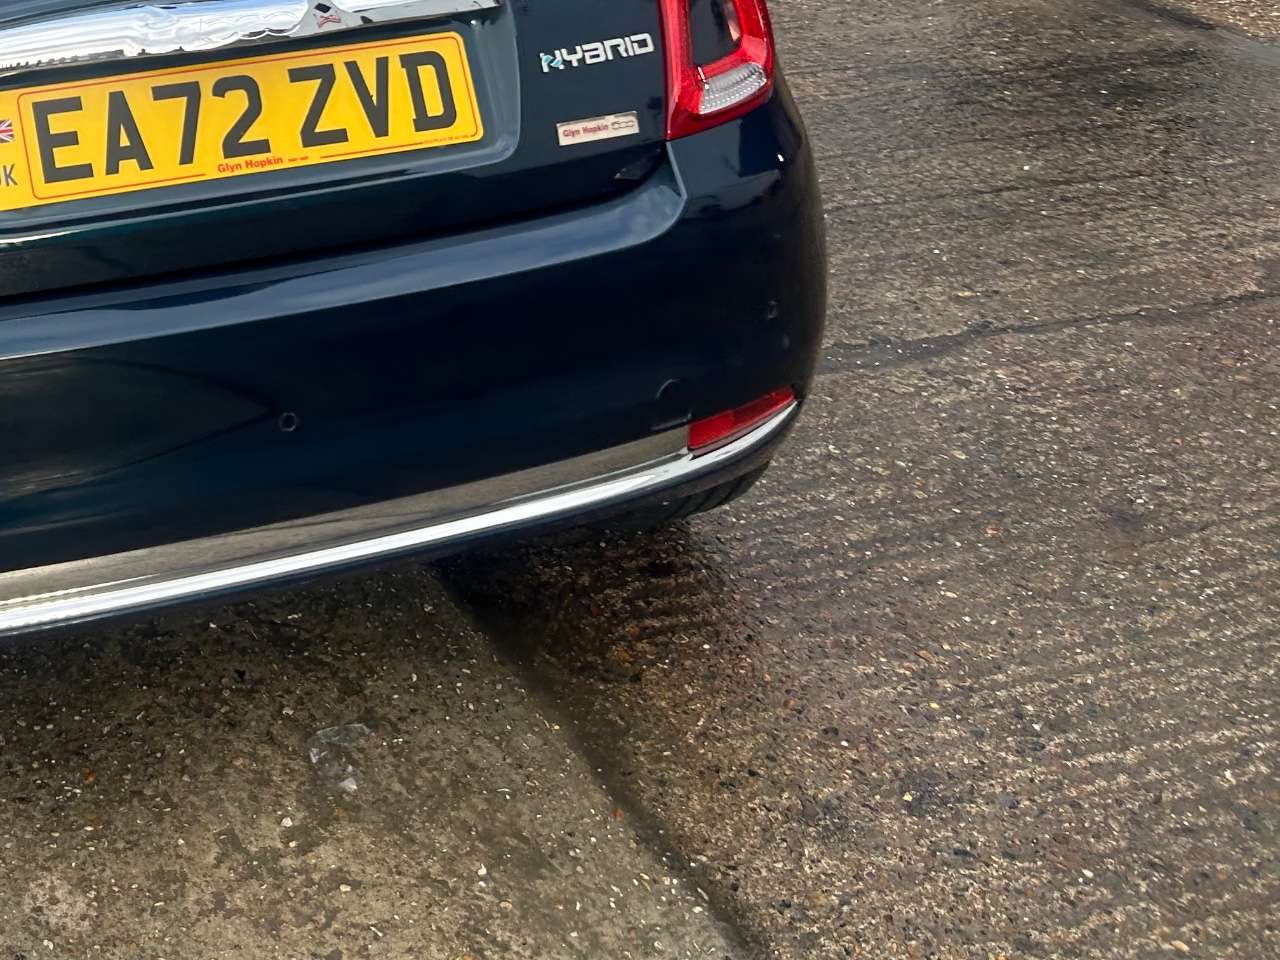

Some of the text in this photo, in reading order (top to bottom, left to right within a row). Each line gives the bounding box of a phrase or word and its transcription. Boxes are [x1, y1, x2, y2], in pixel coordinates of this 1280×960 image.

[540, 33, 655, 72] HYBRID
[31, 50, 458, 185] EA72 ZVD
[217, 162, 243, 174] Glyn
[245, 156, 283, 170] Hopkin
